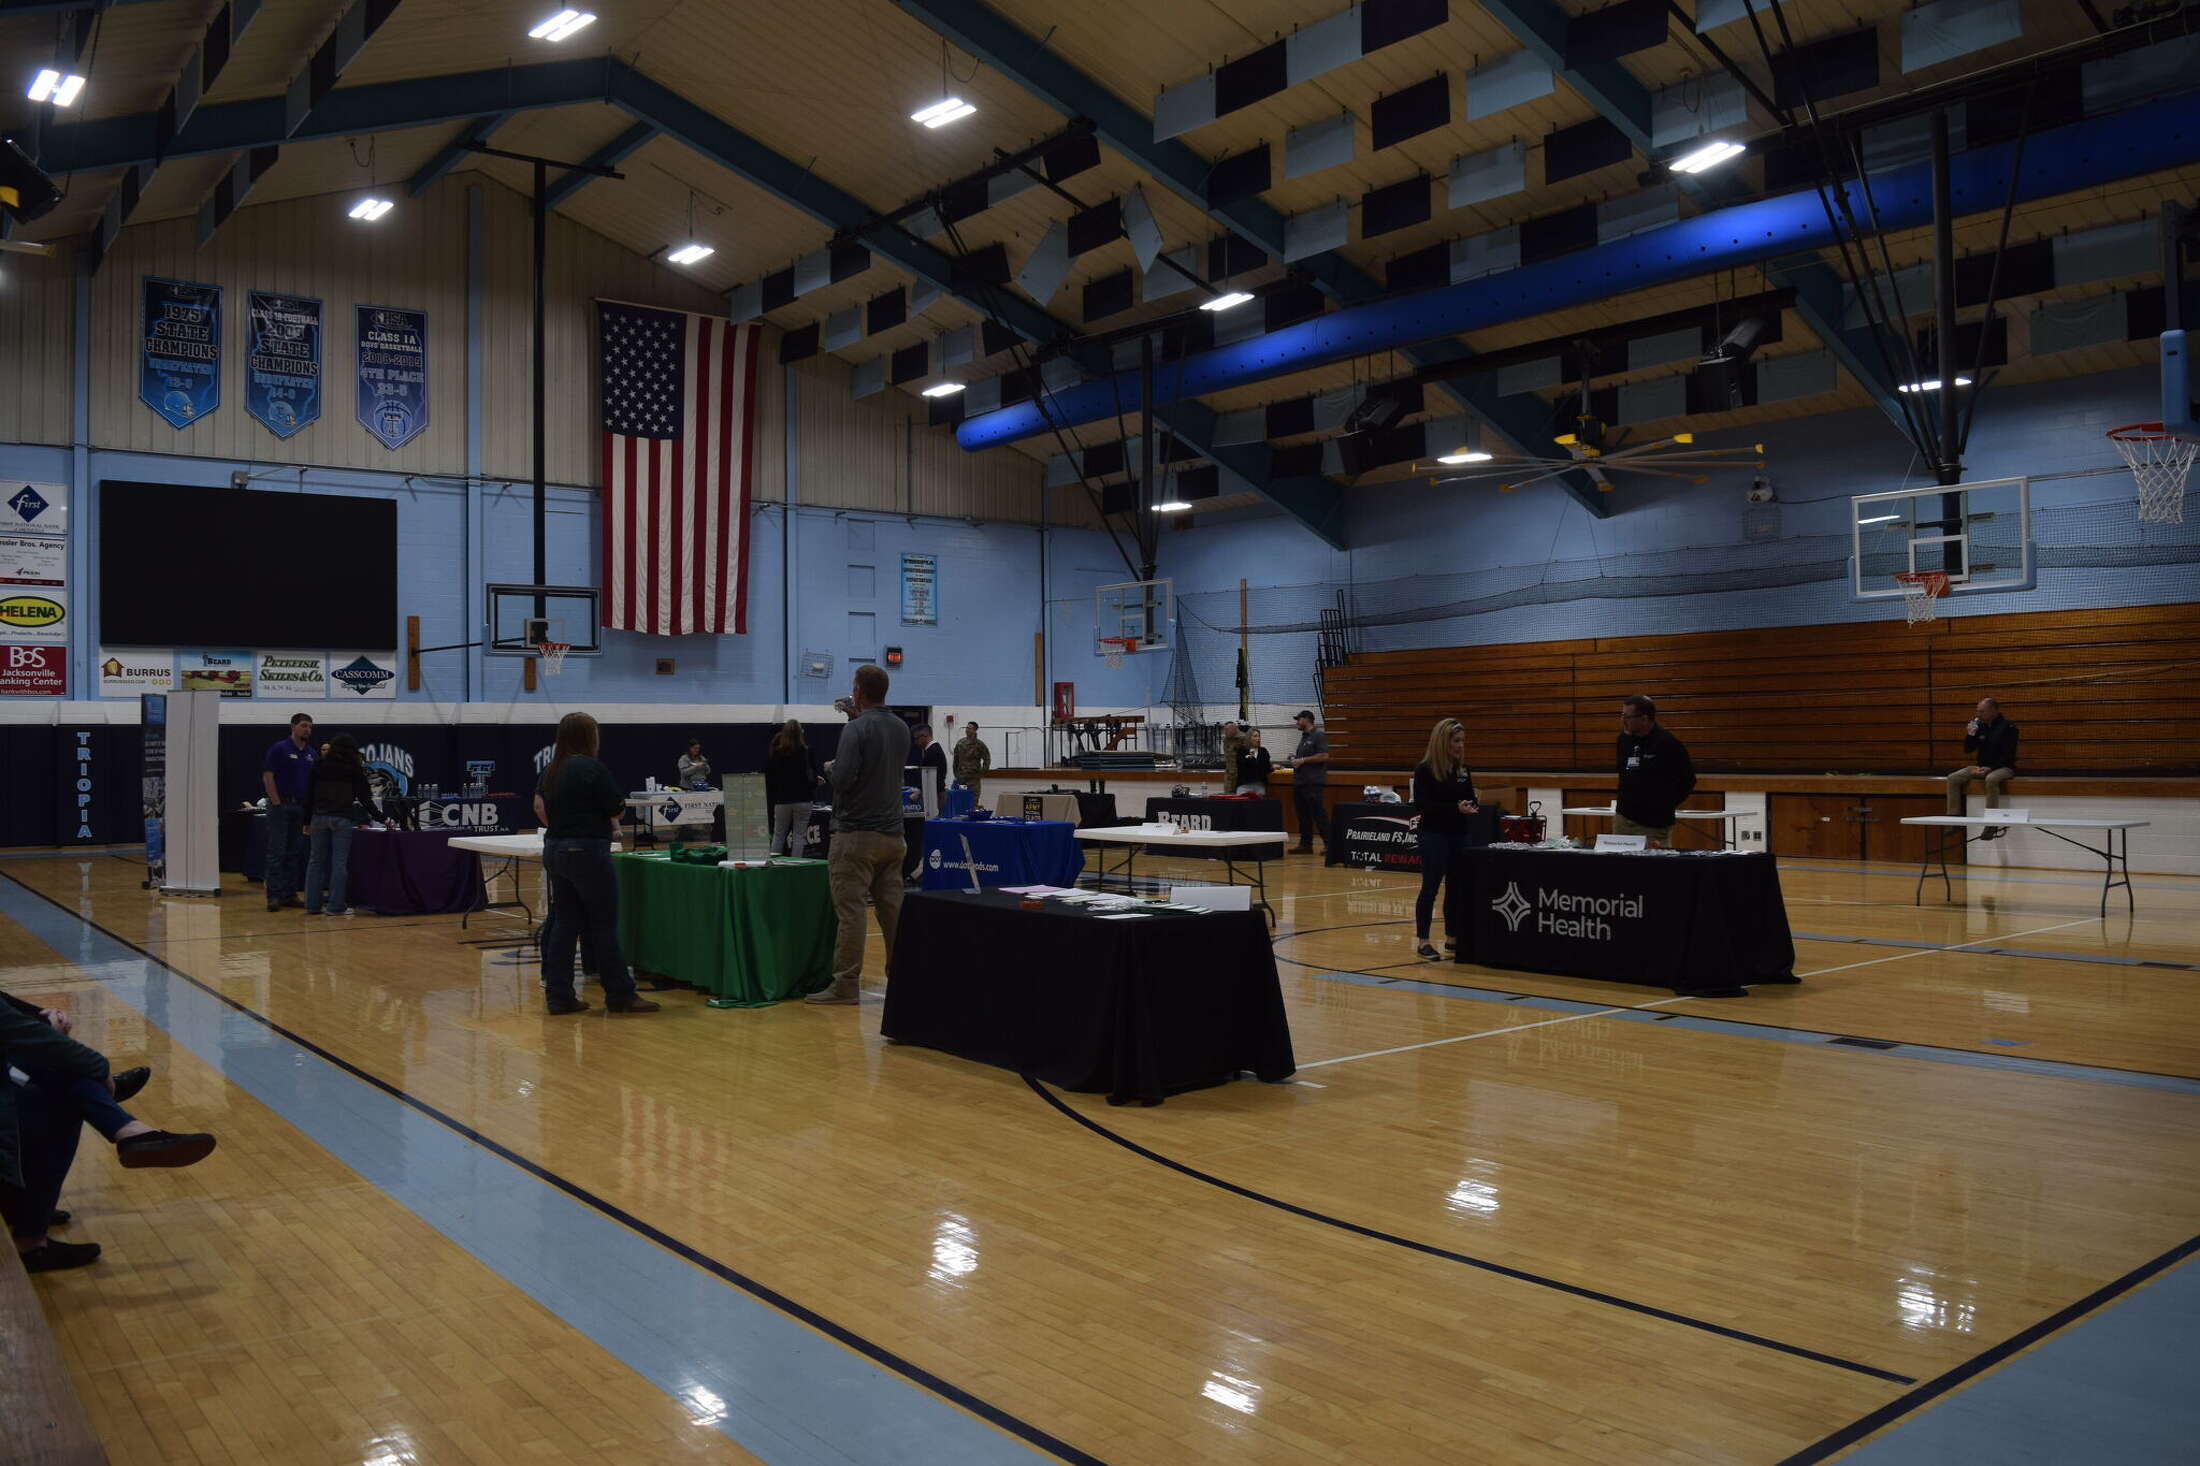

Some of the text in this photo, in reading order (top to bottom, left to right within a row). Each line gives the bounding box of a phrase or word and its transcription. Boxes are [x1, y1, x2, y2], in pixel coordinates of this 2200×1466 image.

[156, 320, 210, 341] STATE
[367, 330, 401, 343] CLASS
[144, 337, 218, 359] CHAMPIONS
[260, 337, 311, 359] STATE
[250, 355, 320, 377] CHAMPIONS
[39, 541, 65, 551] Agency
[0, 606, 57, 618] HELENA
[0, 677, 63, 687] anking Center
[2, 669, 55, 678] Jacksonville
[126, 668, 171, 677] BURRUS
[335, 669, 389, 680] CASSCOMM
[76, 731, 93, 839] TRIOPIA
[442, 802, 499, 827] CNB
[1157, 811, 1212, 831] BEARD
[1350, 850, 1382, 862] TOTAL
[1538, 887, 1644, 919] Memorial
[1538, 911, 1612, 941] Health
